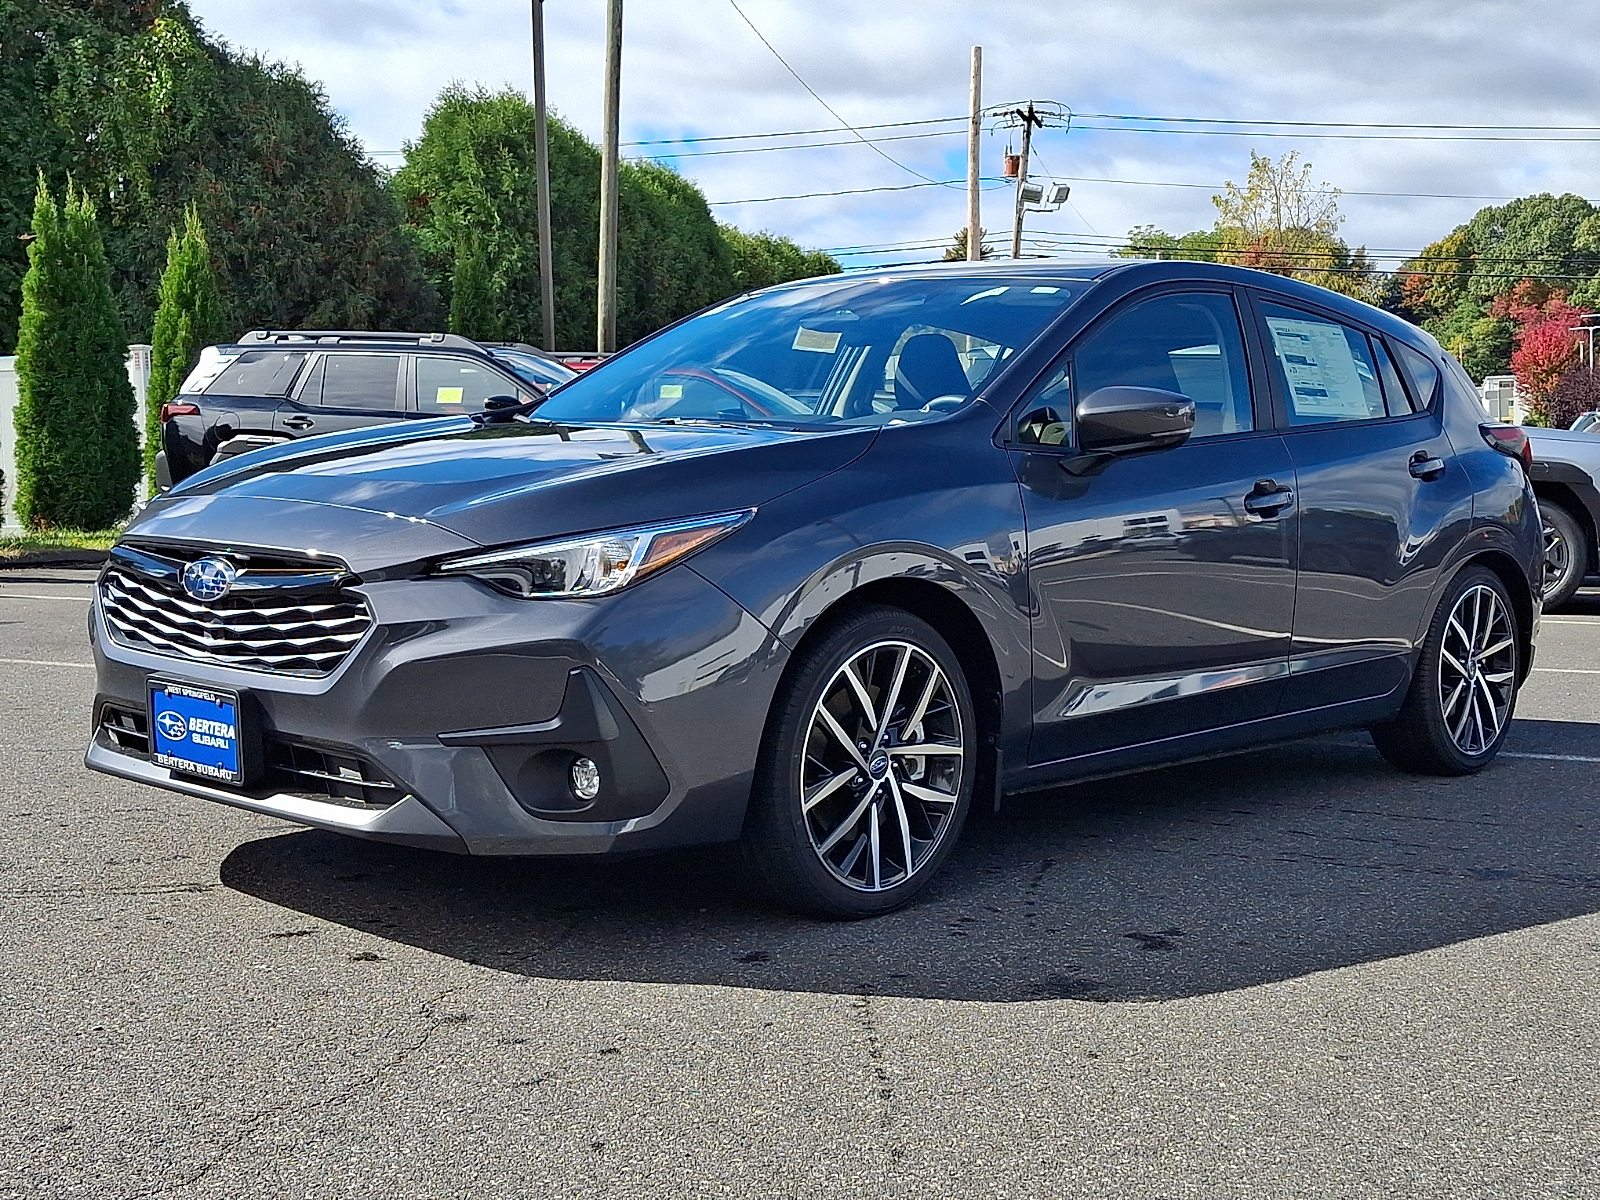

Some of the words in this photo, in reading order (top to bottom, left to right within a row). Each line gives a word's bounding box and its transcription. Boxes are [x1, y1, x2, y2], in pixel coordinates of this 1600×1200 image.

[189, 717, 236, 740] BERTERA
[191, 733, 230, 749] SUBARU
[157, 754, 195, 771] BERTERA
[196, 764, 232, 780] SUBARU
